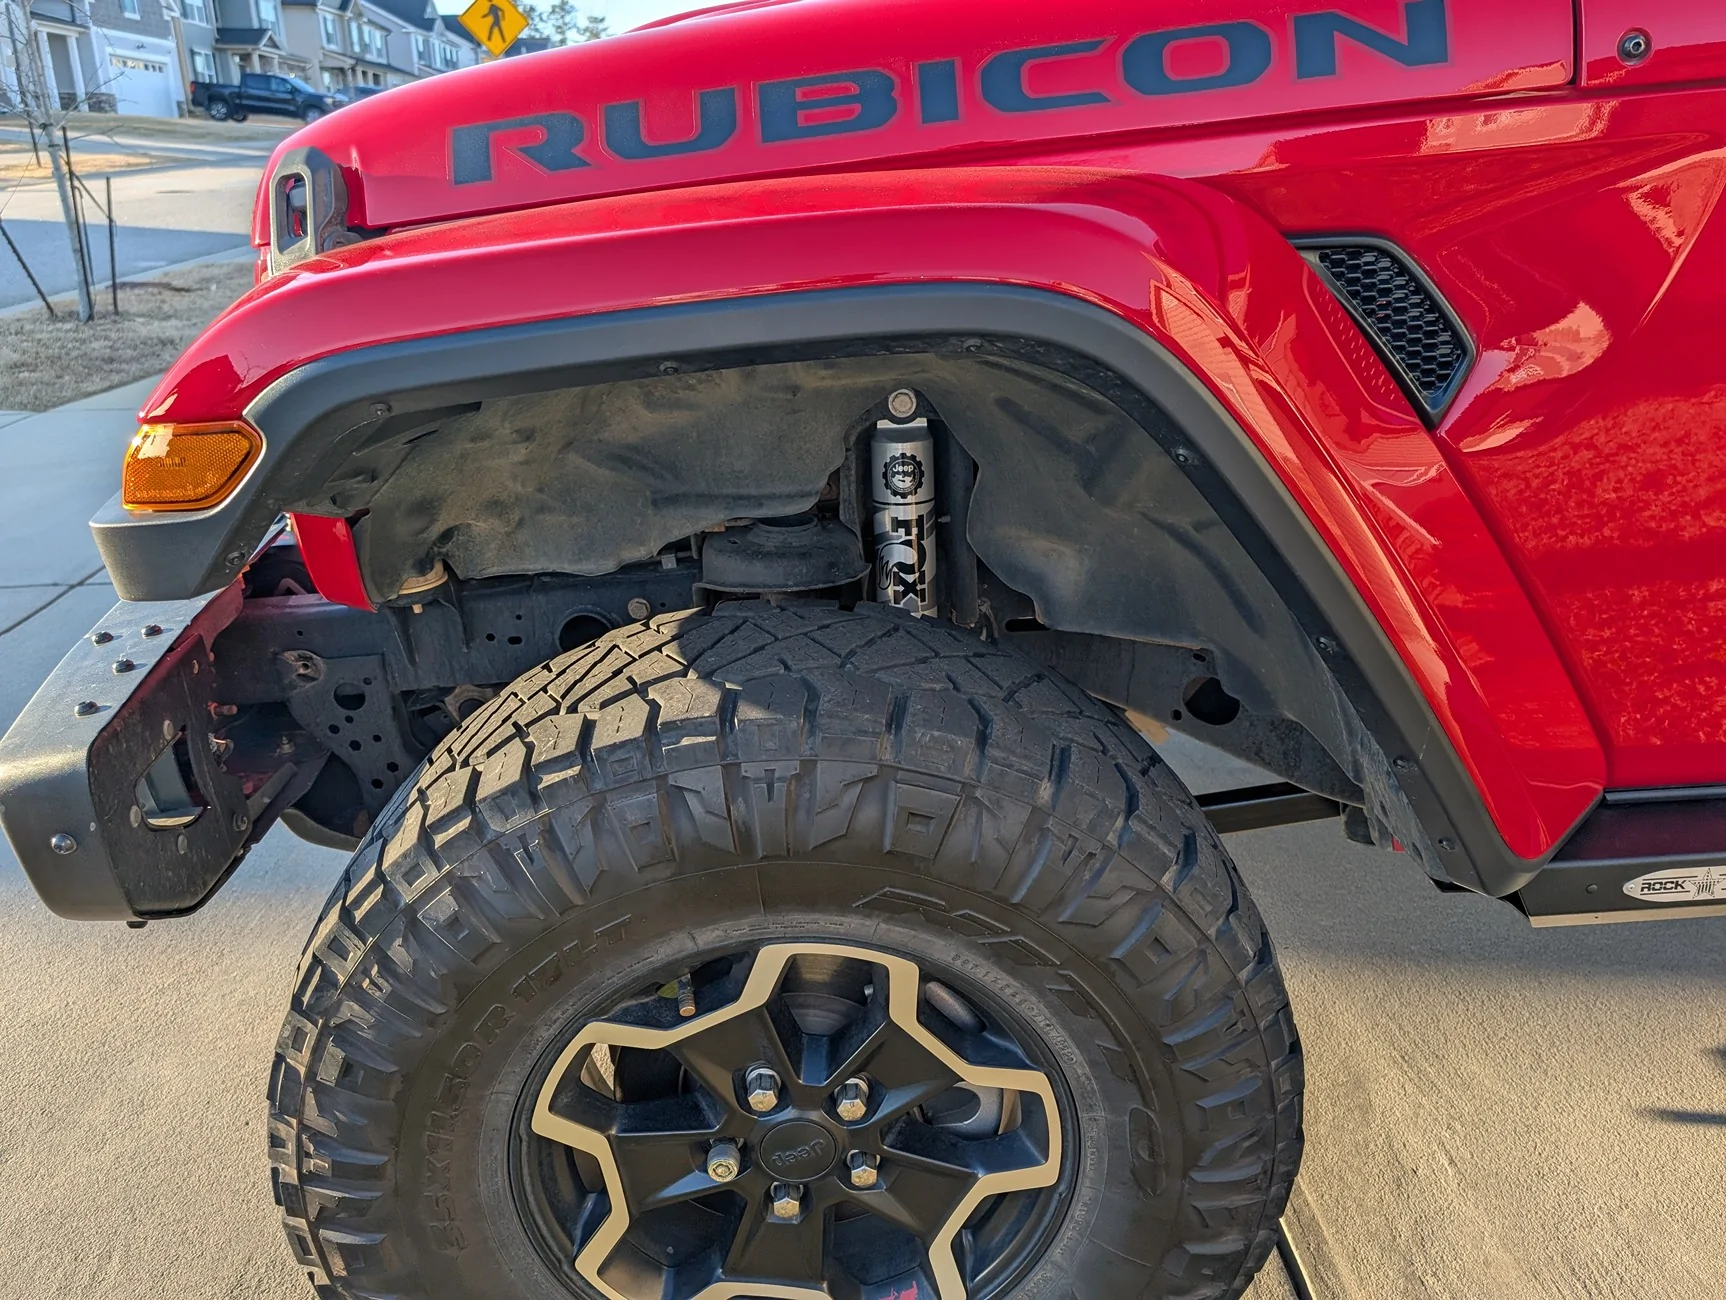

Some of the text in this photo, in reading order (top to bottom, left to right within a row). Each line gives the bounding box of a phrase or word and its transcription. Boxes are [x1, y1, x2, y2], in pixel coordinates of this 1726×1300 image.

[452, 0, 1449, 184] RUBICON
[892, 464, 914, 472] Jeep
[878, 513, 926, 605] FOX
[1640, 879, 1687, 892] ROCK
[770, 1139, 827, 1167] Jeep
